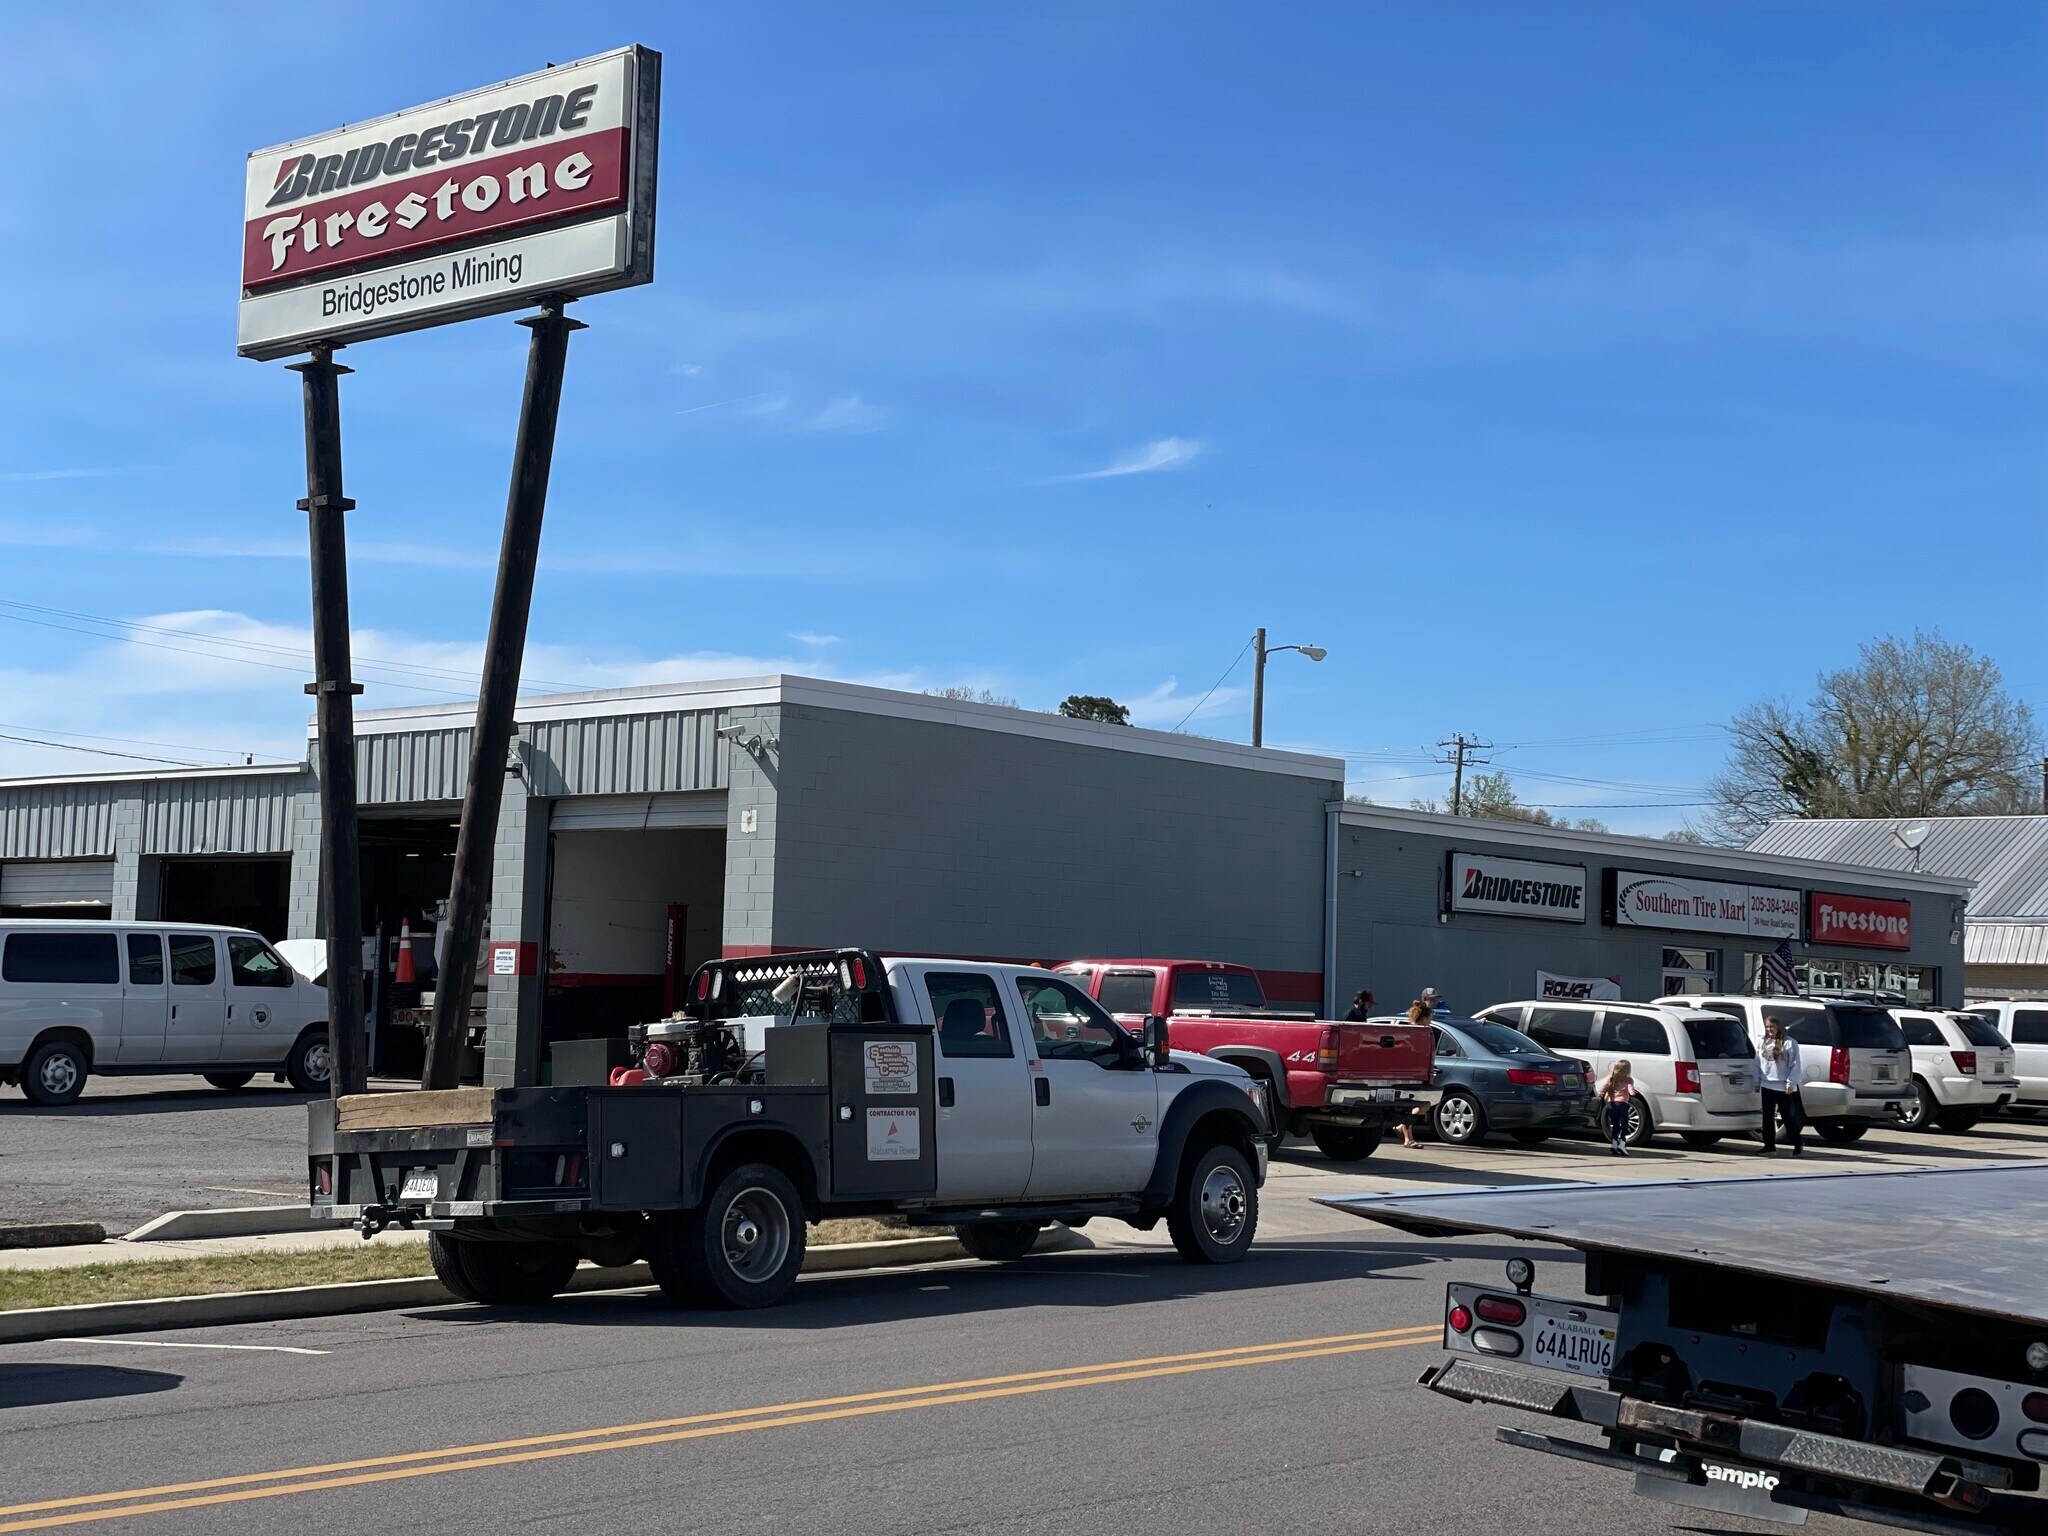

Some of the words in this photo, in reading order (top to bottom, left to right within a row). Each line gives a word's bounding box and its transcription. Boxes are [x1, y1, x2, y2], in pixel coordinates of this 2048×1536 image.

[266, 84, 598, 208] BRIDGESTONE
[262, 151, 594, 272] Firestone
[322, 269, 445, 317] Bridgestone
[451, 252, 523, 290] Mining
[1462, 868, 1582, 909] BRIDGESTONE
[1636, 889, 1690, 916] Southern
[1692, 895, 1717, 918] Tire
[1719, 898, 1747, 921] Mart
[1751, 895, 1799, 916] 205-384-3449
[1819, 904, 1908, 935] Firestone
[1754, 916, 1760, 926] 24
[1760, 917, 1770, 927] Hour
[1770, 918, 1780, 928] Road
[1780, 919, 1795, 929] Service
[666, 918, 674, 966] HUNTER
[1542, 980, 1594, 999] ROUGH
[869, 1145, 898, 1156] Alabama
[899, 1145, 918, 1155] Power
[1556, 1322, 1597, 1336] ALABAMA
[1535, 1330, 1611, 1367] 64A1RU6
[1565, 1362, 1581, 1371] TRUCK
